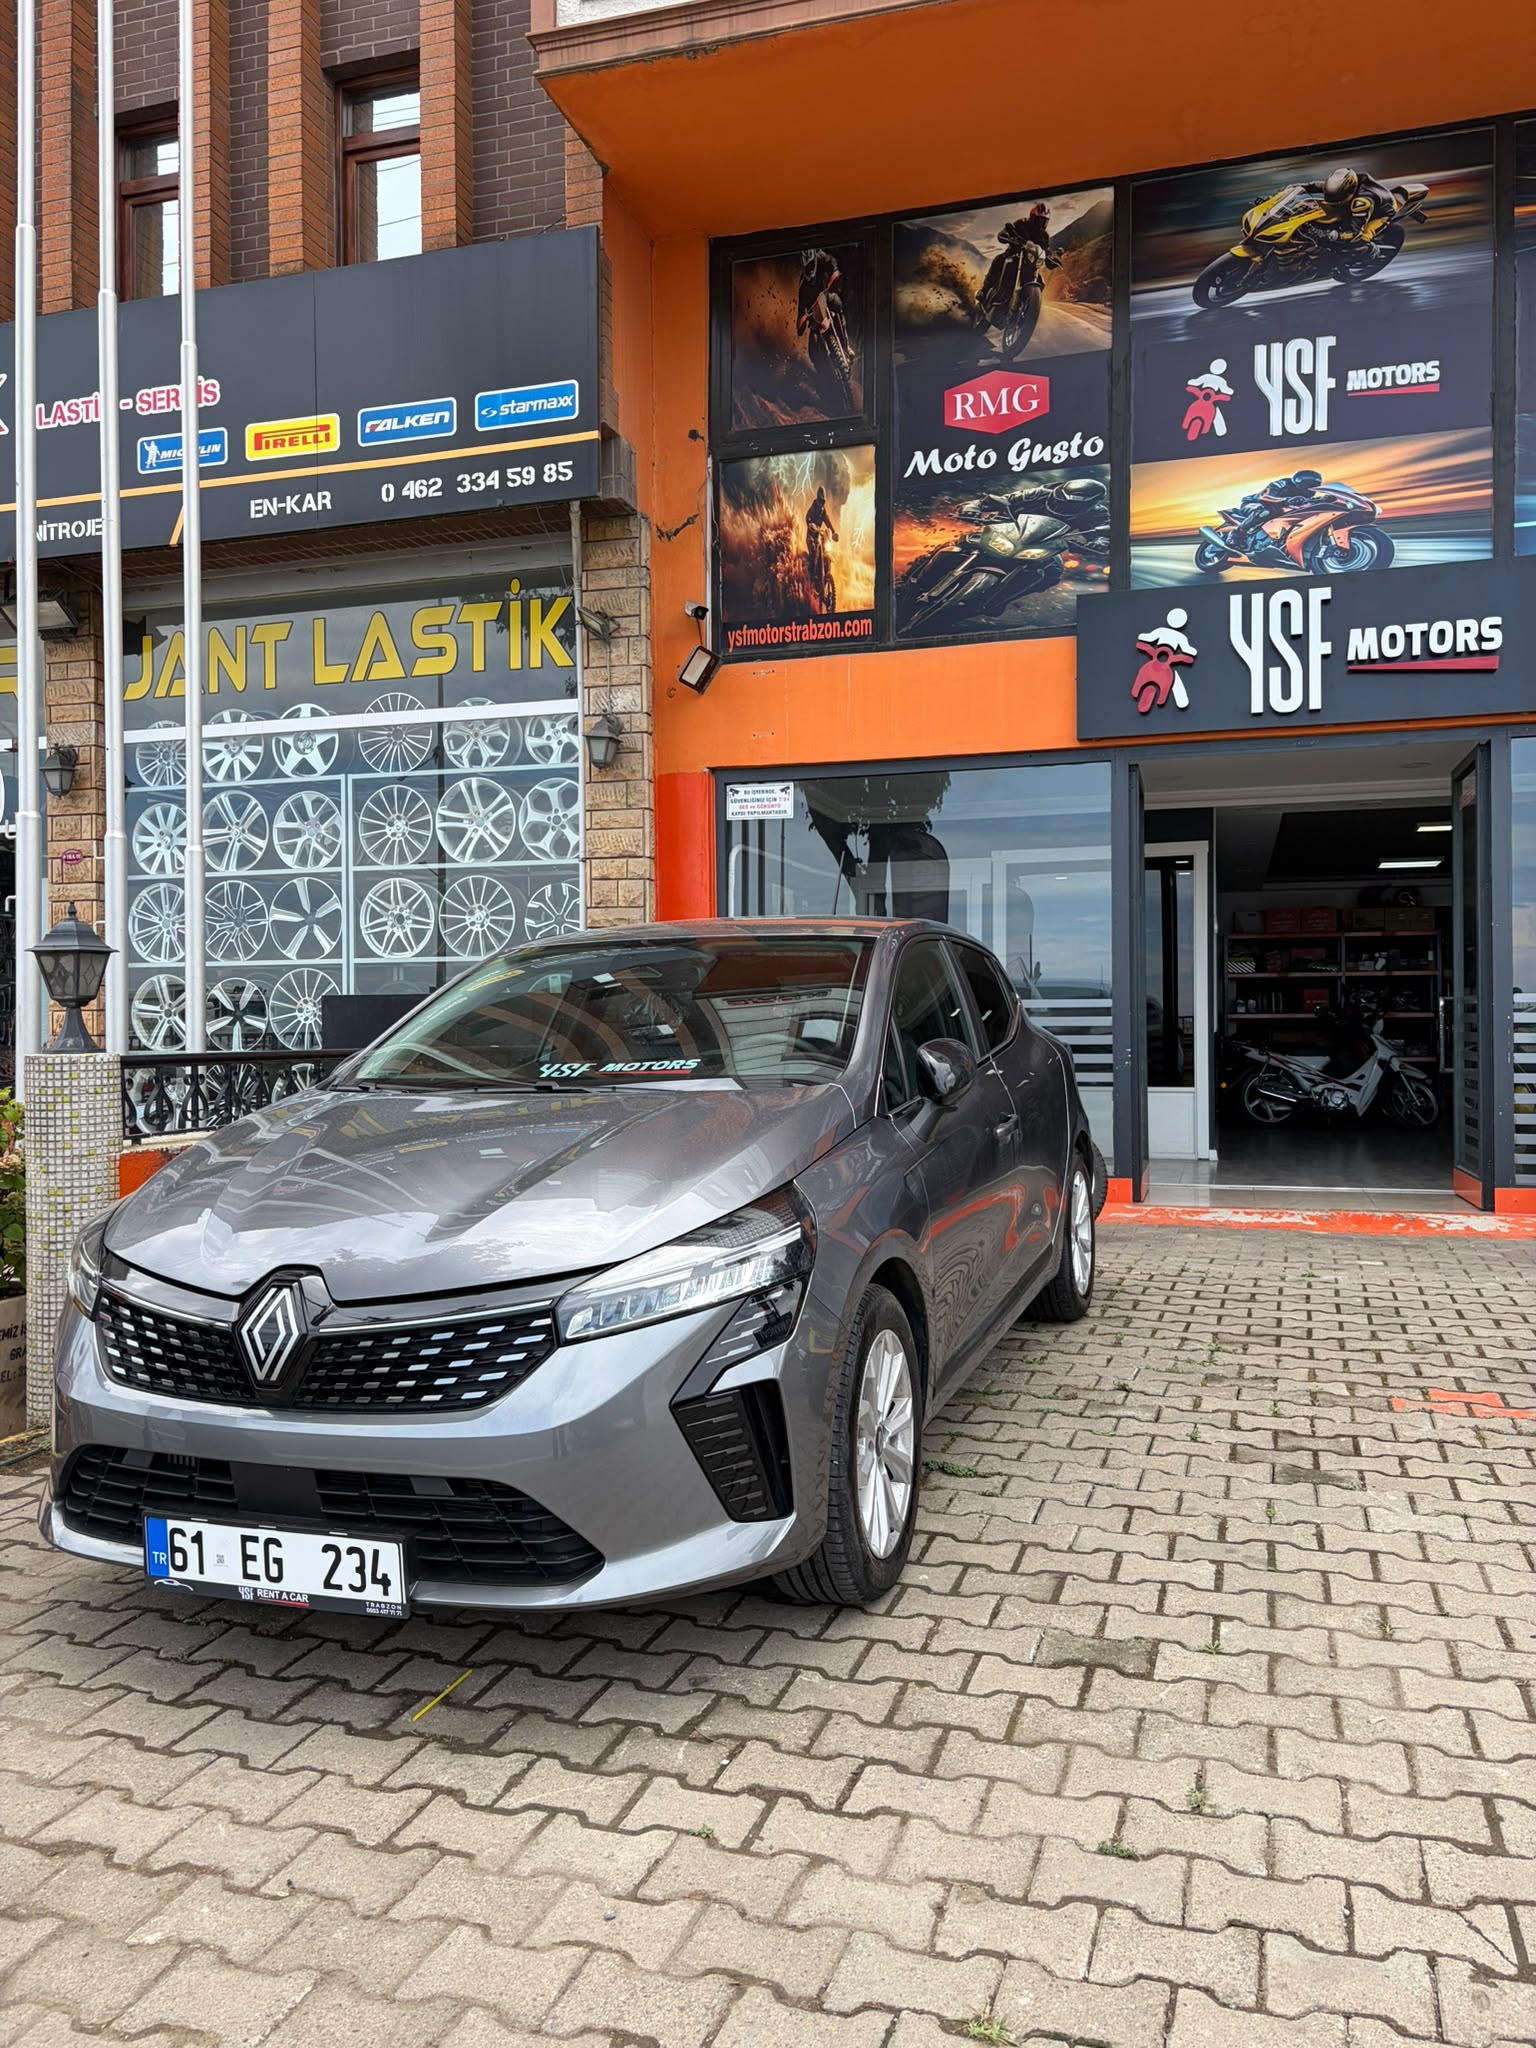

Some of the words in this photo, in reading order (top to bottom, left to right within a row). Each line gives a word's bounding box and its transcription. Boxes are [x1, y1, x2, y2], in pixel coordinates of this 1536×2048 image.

[36, 391, 101, 429] LASTİ
[136, 376, 220, 415] SERİS
[952, 384, 1041, 421] RMG
[1254, 336, 1337, 437] YSF
[1346, 359, 1440, 390] MOTORS
[364, 410, 450, 434] FALKEN
[499, 394, 574, 416] starmaxx
[160, 443, 222, 460] MICLIN
[253, 424, 331, 451] PIRELLI
[903, 443, 997, 478] Moto
[1007, 432, 1104, 472] Gusto
[36, 518, 104, 542] NİTROJE
[250, 491, 332, 519] EN-KAR
[381, 483, 395, 502] 0
[401, 477, 443, 500] 462
[456, 470, 499, 494] 334
[506, 466, 536, 488] 59
[543, 461, 573, 483] 85
[123, 620, 294, 702] JANT
[313, 577, 577, 686] LASTİK
[727, 618, 872, 653] ysfmotorstrabzon.com
[1229, 587, 1333, 714] YSF
[1347, 616, 1503, 662] MOTORS
[539, 1062, 597, 1078] YSF
[599, 1059, 701, 1072] MOTORS
[151, 1550, 168, 1566] TR
[169, 1527, 205, 1576] 61
[240, 1534, 284, 1584] EG
[321, 1543, 392, 1596] 234
[238, 1586, 254, 1601] YSF
[257, 1588, 280, 1600] RENT
[281, 1591, 289, 1600] A
[289, 1593, 309, 1603] CAR
[365, 1601, 402, 1610] TRABZON
